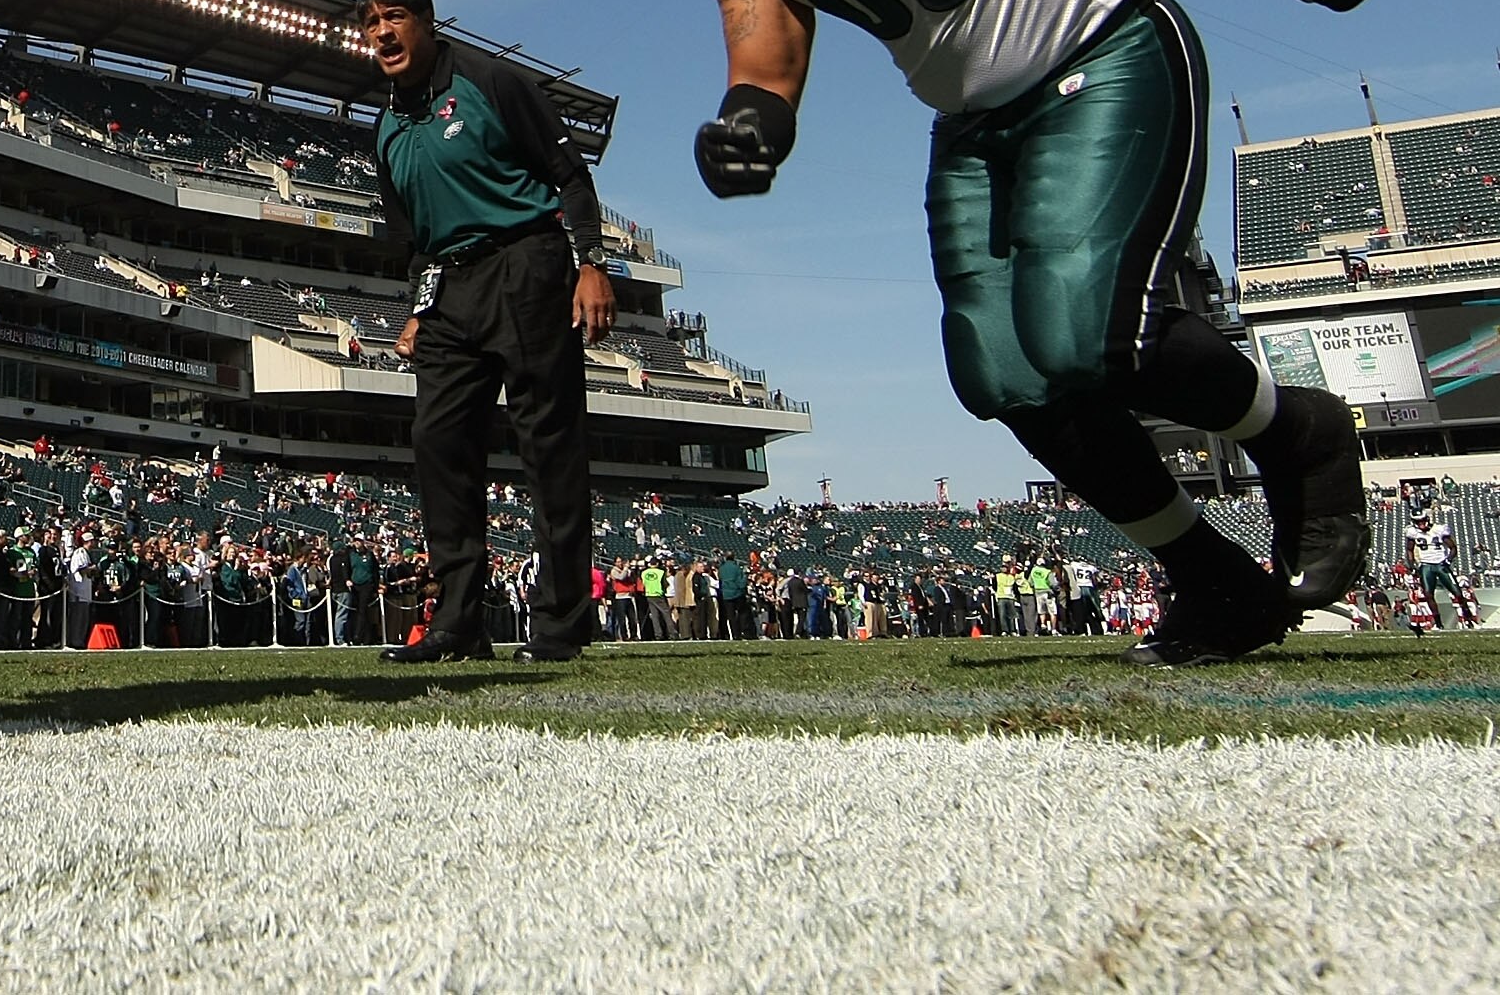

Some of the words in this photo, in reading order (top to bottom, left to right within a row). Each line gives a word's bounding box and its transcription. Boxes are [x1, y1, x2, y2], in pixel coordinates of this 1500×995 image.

[1313, 327, 1352, 340] YOUR
[1354, 323, 1400, 336] TEAM.
[1322, 339, 1352, 351] OUR
[1355, 334, 1409, 348] TICKET.
[128, 352, 174, 371] CHEERLEADER
[1386, 408, 1419, 422] 15:00
